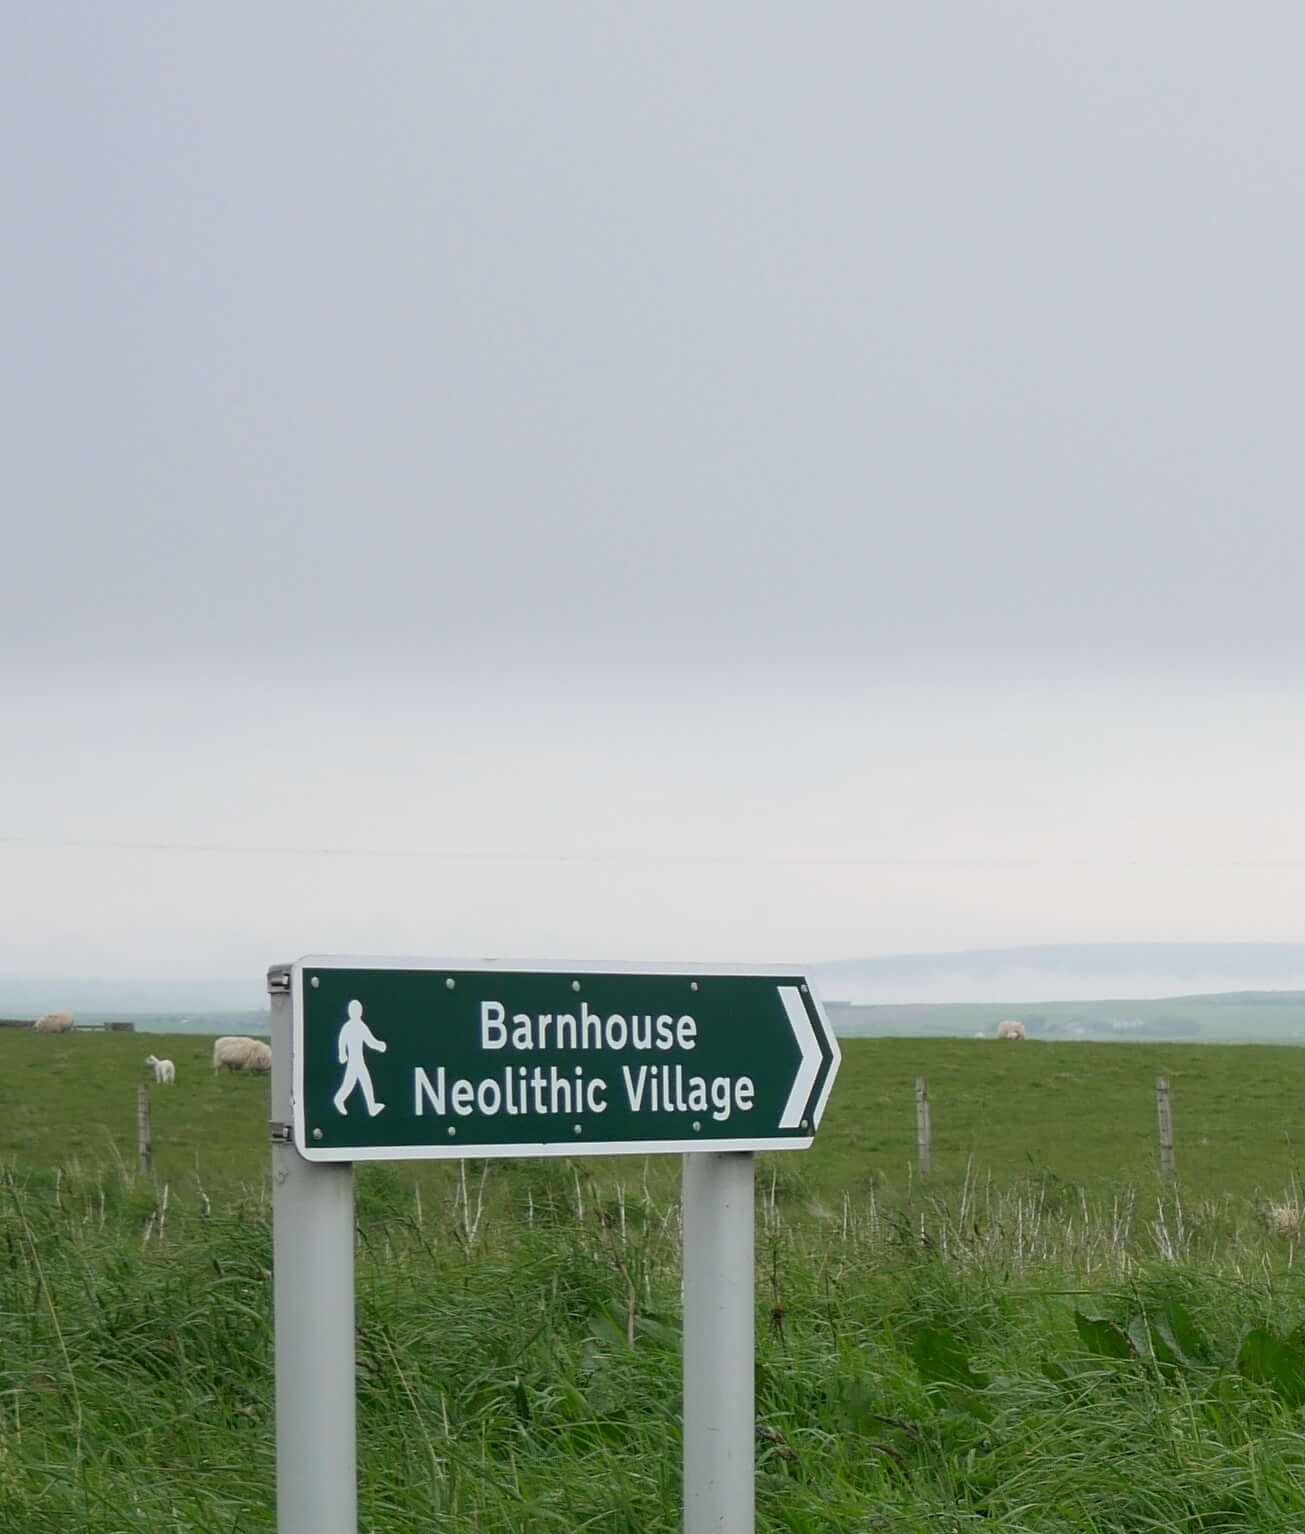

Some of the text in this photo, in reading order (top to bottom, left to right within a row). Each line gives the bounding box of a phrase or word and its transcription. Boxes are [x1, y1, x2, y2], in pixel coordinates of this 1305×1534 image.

[480, 1000, 698, 1051] Barnhouse
[414, 1064, 756, 1122] Neolithic Village
